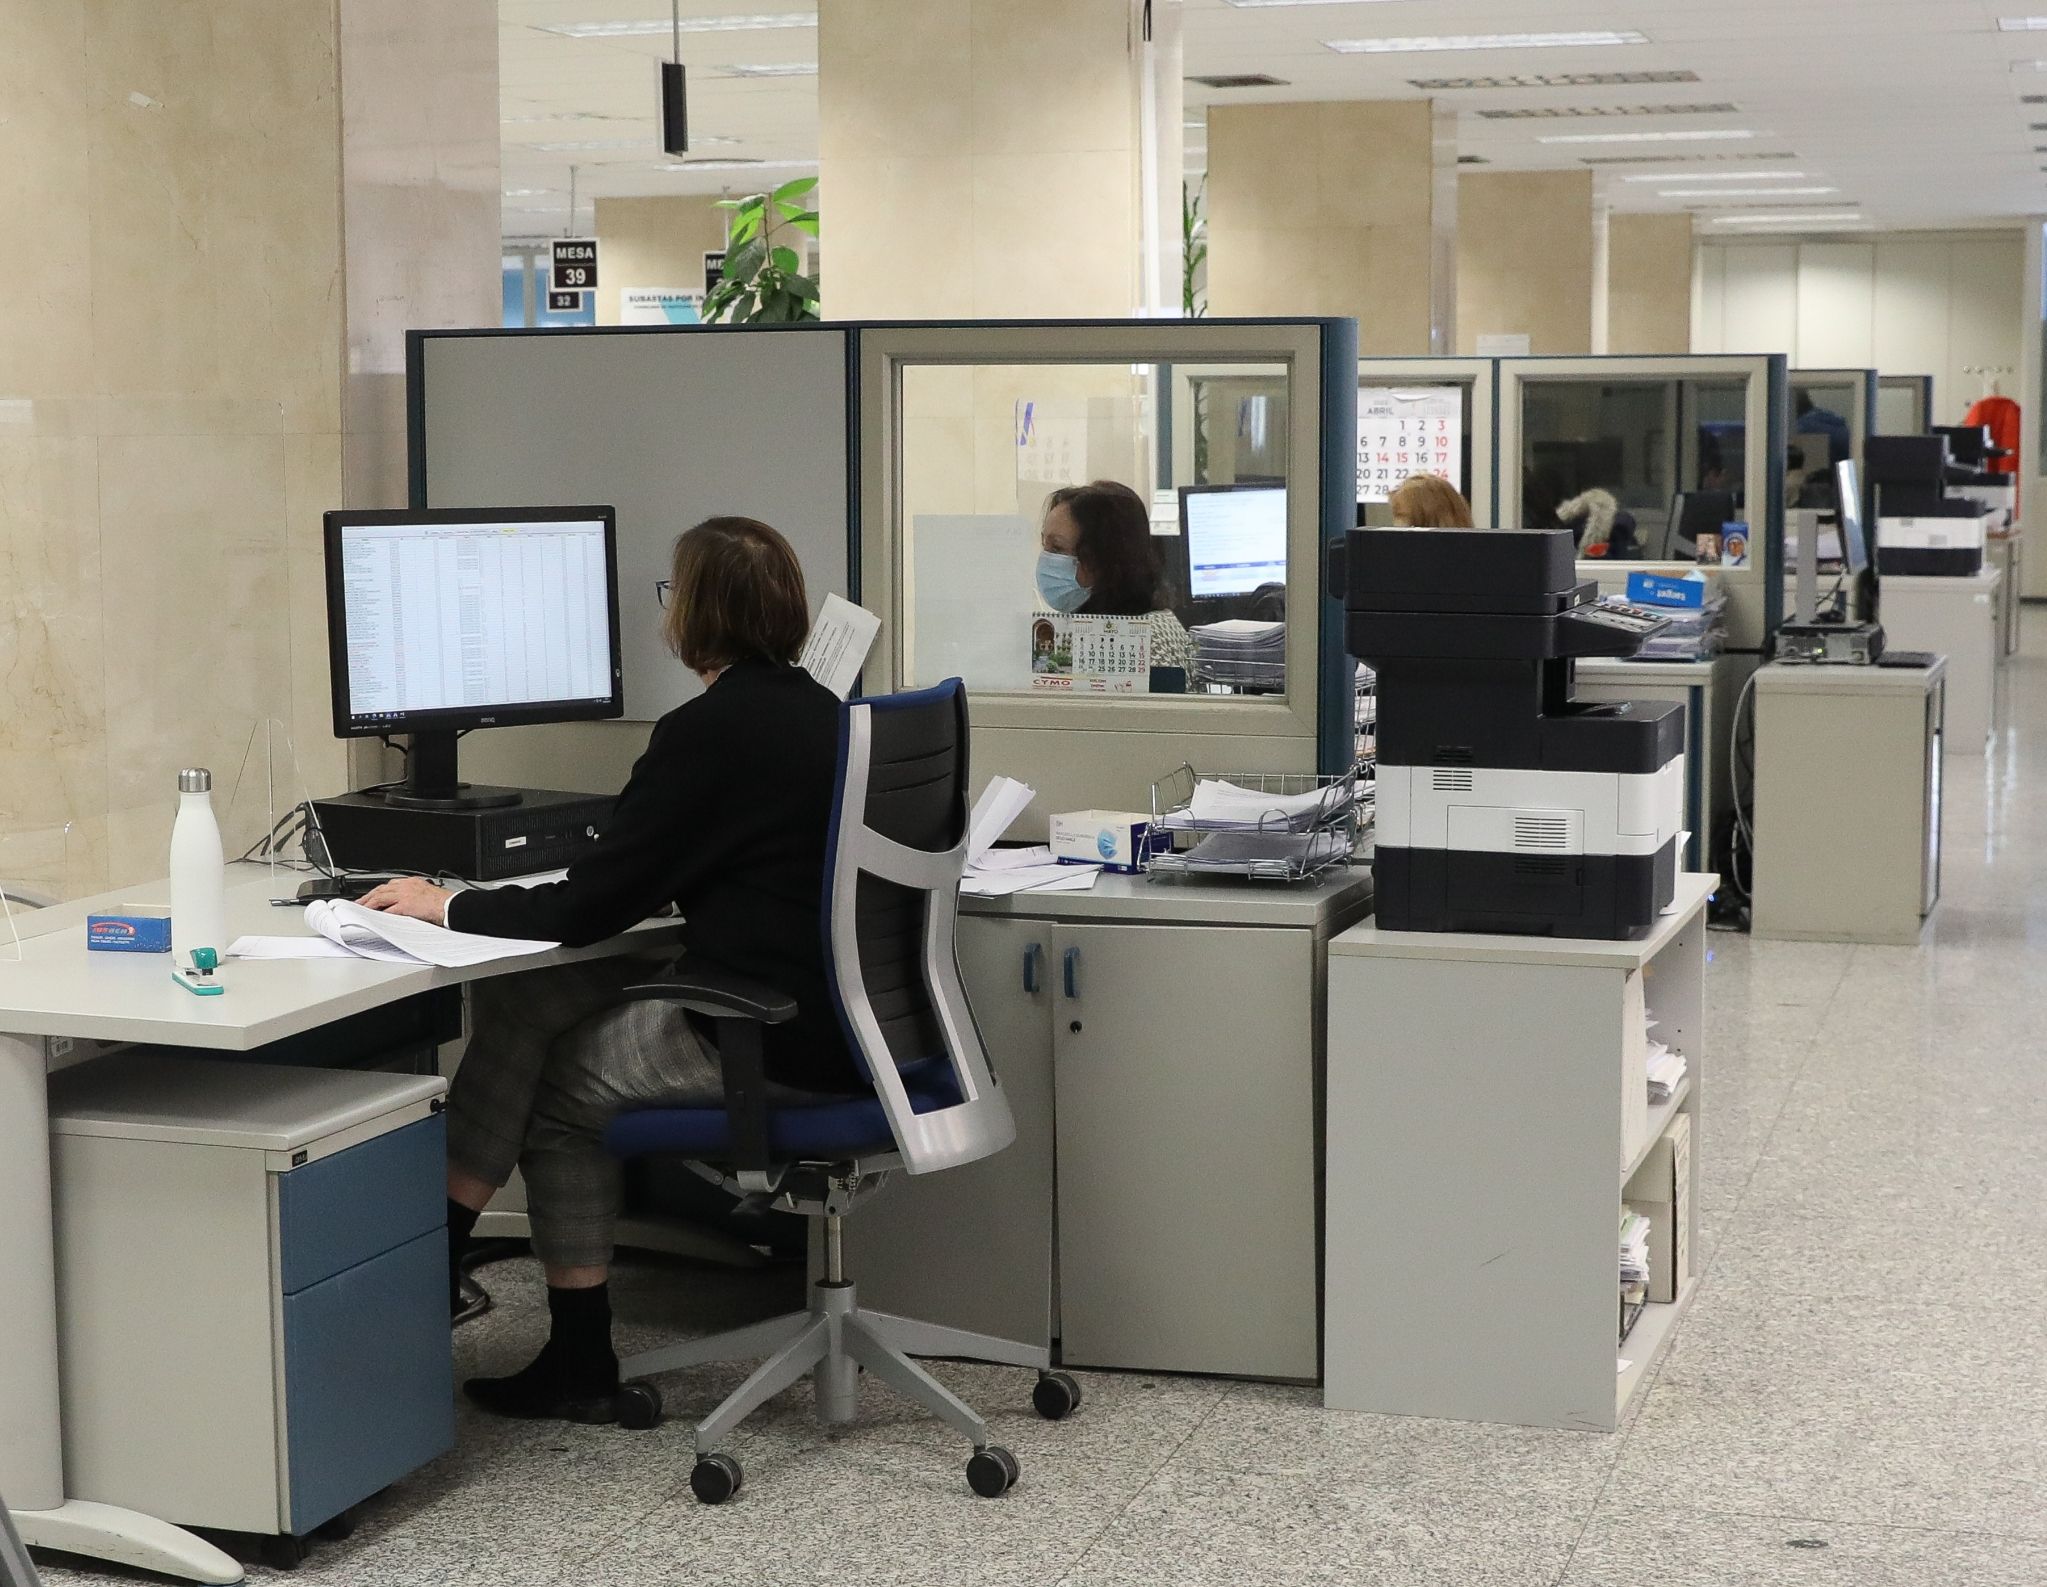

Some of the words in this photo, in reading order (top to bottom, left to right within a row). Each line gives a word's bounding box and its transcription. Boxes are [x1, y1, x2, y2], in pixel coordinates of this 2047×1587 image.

[556, 247, 594, 259] MESA
[565, 269, 586, 285] 39
[1367, 407, 1394, 415] ABRIL
[1400, 420, 1405, 431] 1
[1419, 420, 1425, 431] 2
[1438, 420, 1445, 431] 3
[1360, 436, 1368, 447] 6
[1379, 436, 1387, 447] 7
[1399, 436, 1406, 447] 8
[1418, 436, 1425, 447] 9
[1435, 436, 1448, 447] 10
[1358, 453, 1369, 463] 13
[1376, 453, 1389, 463] 14
[1397, 453, 1408, 463] 15
[1416, 453, 1428, 463] 16
[1435, 453, 1447, 463] 17
[1357, 469, 1370, 479] 20
[1377, 469, 1388, 479] 21
[1395, 469, 1409, 479] 22
[1357, 485, 1370, 495] 27
[1375, 485, 1389, 495] 28
